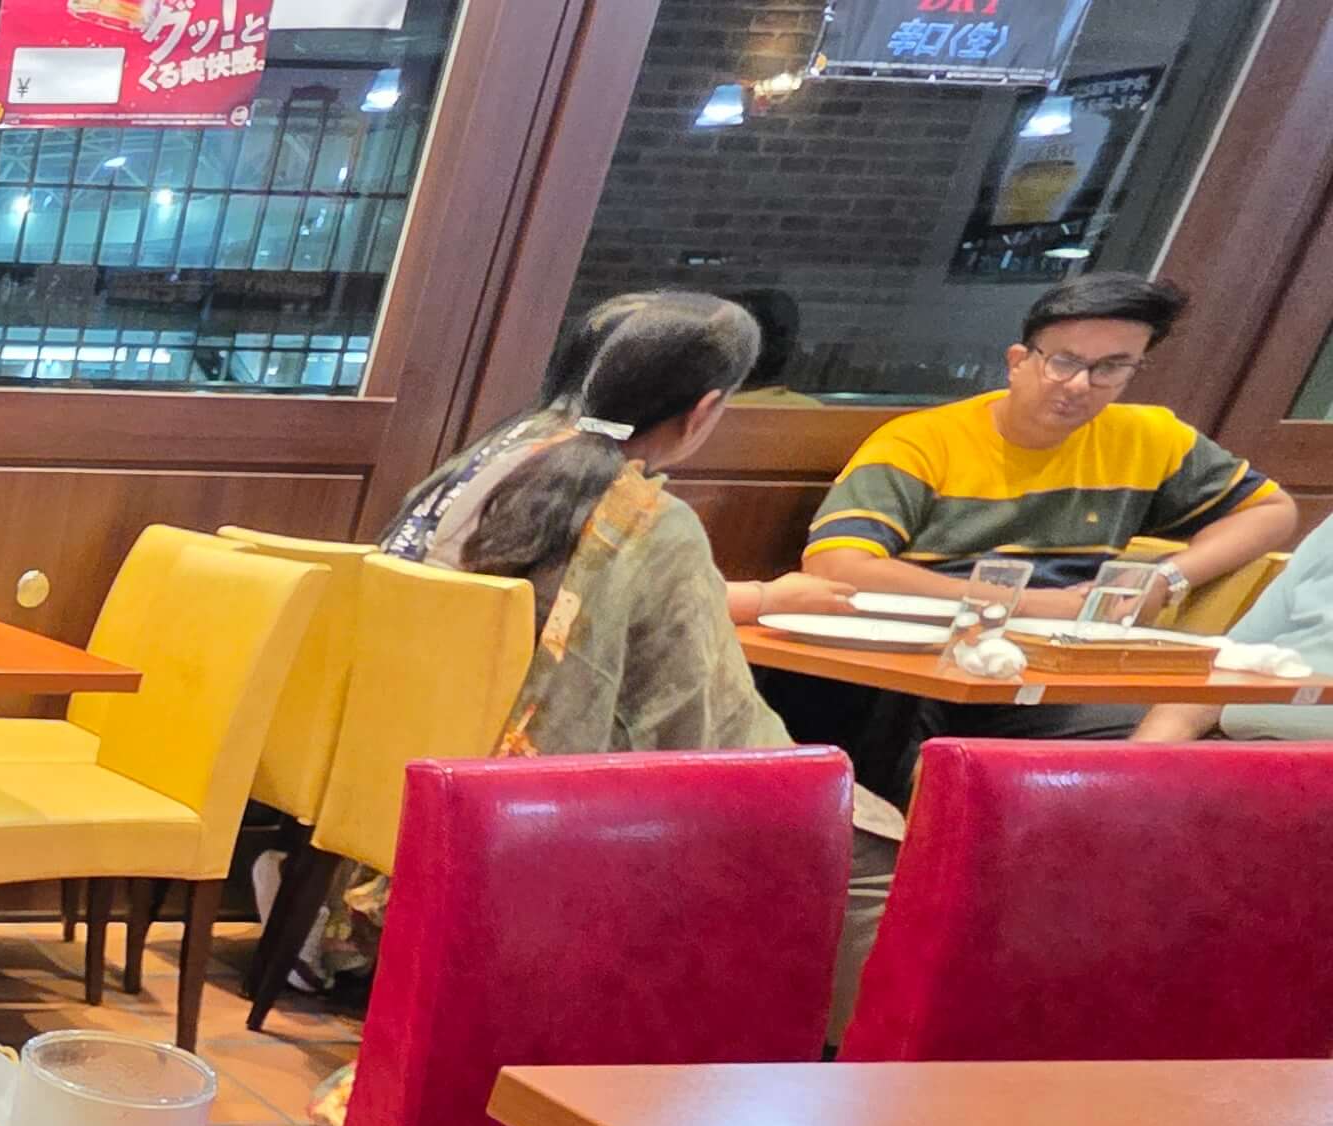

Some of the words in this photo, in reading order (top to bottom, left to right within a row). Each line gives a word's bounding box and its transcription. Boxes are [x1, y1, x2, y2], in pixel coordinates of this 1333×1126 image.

[138, 46, 266, 92] くる爽快感。
[17, 77, 31, 98] ¥
